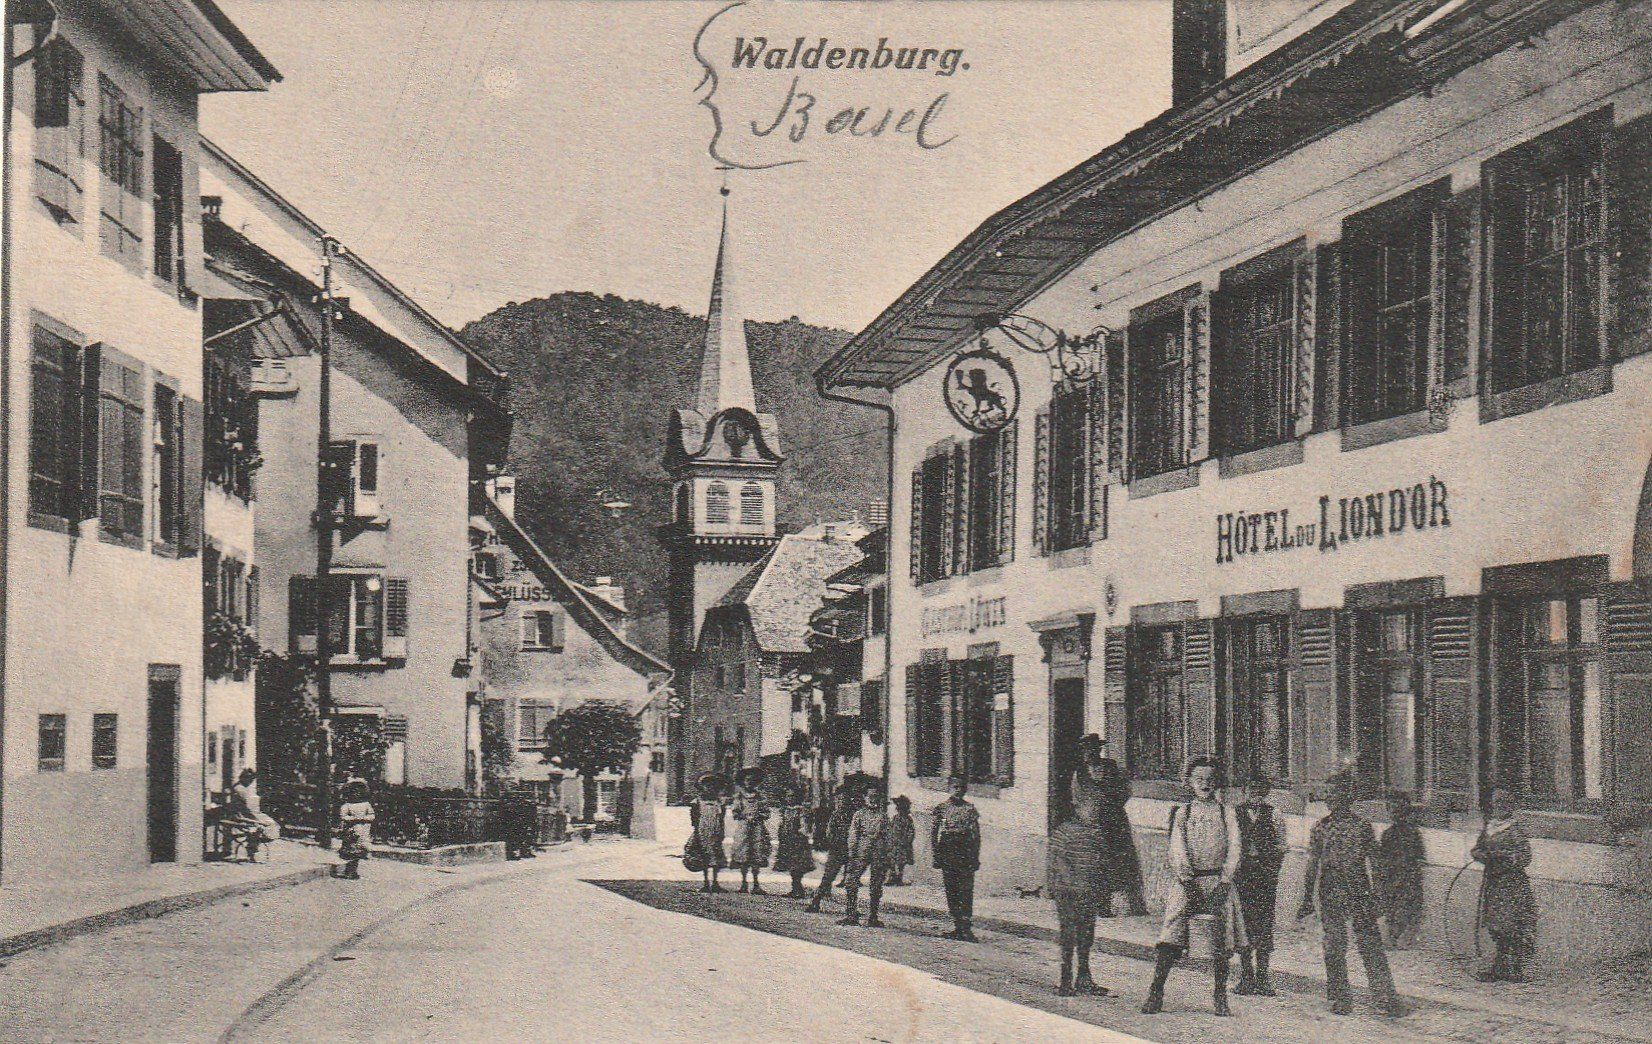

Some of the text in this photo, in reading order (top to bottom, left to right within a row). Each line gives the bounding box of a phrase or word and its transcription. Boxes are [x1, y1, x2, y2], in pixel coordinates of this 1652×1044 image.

[750, 75, 960, 151] Basel
[1216, 508, 1294, 565] HÔTEL
[1295, 523, 1317, 548] DU
